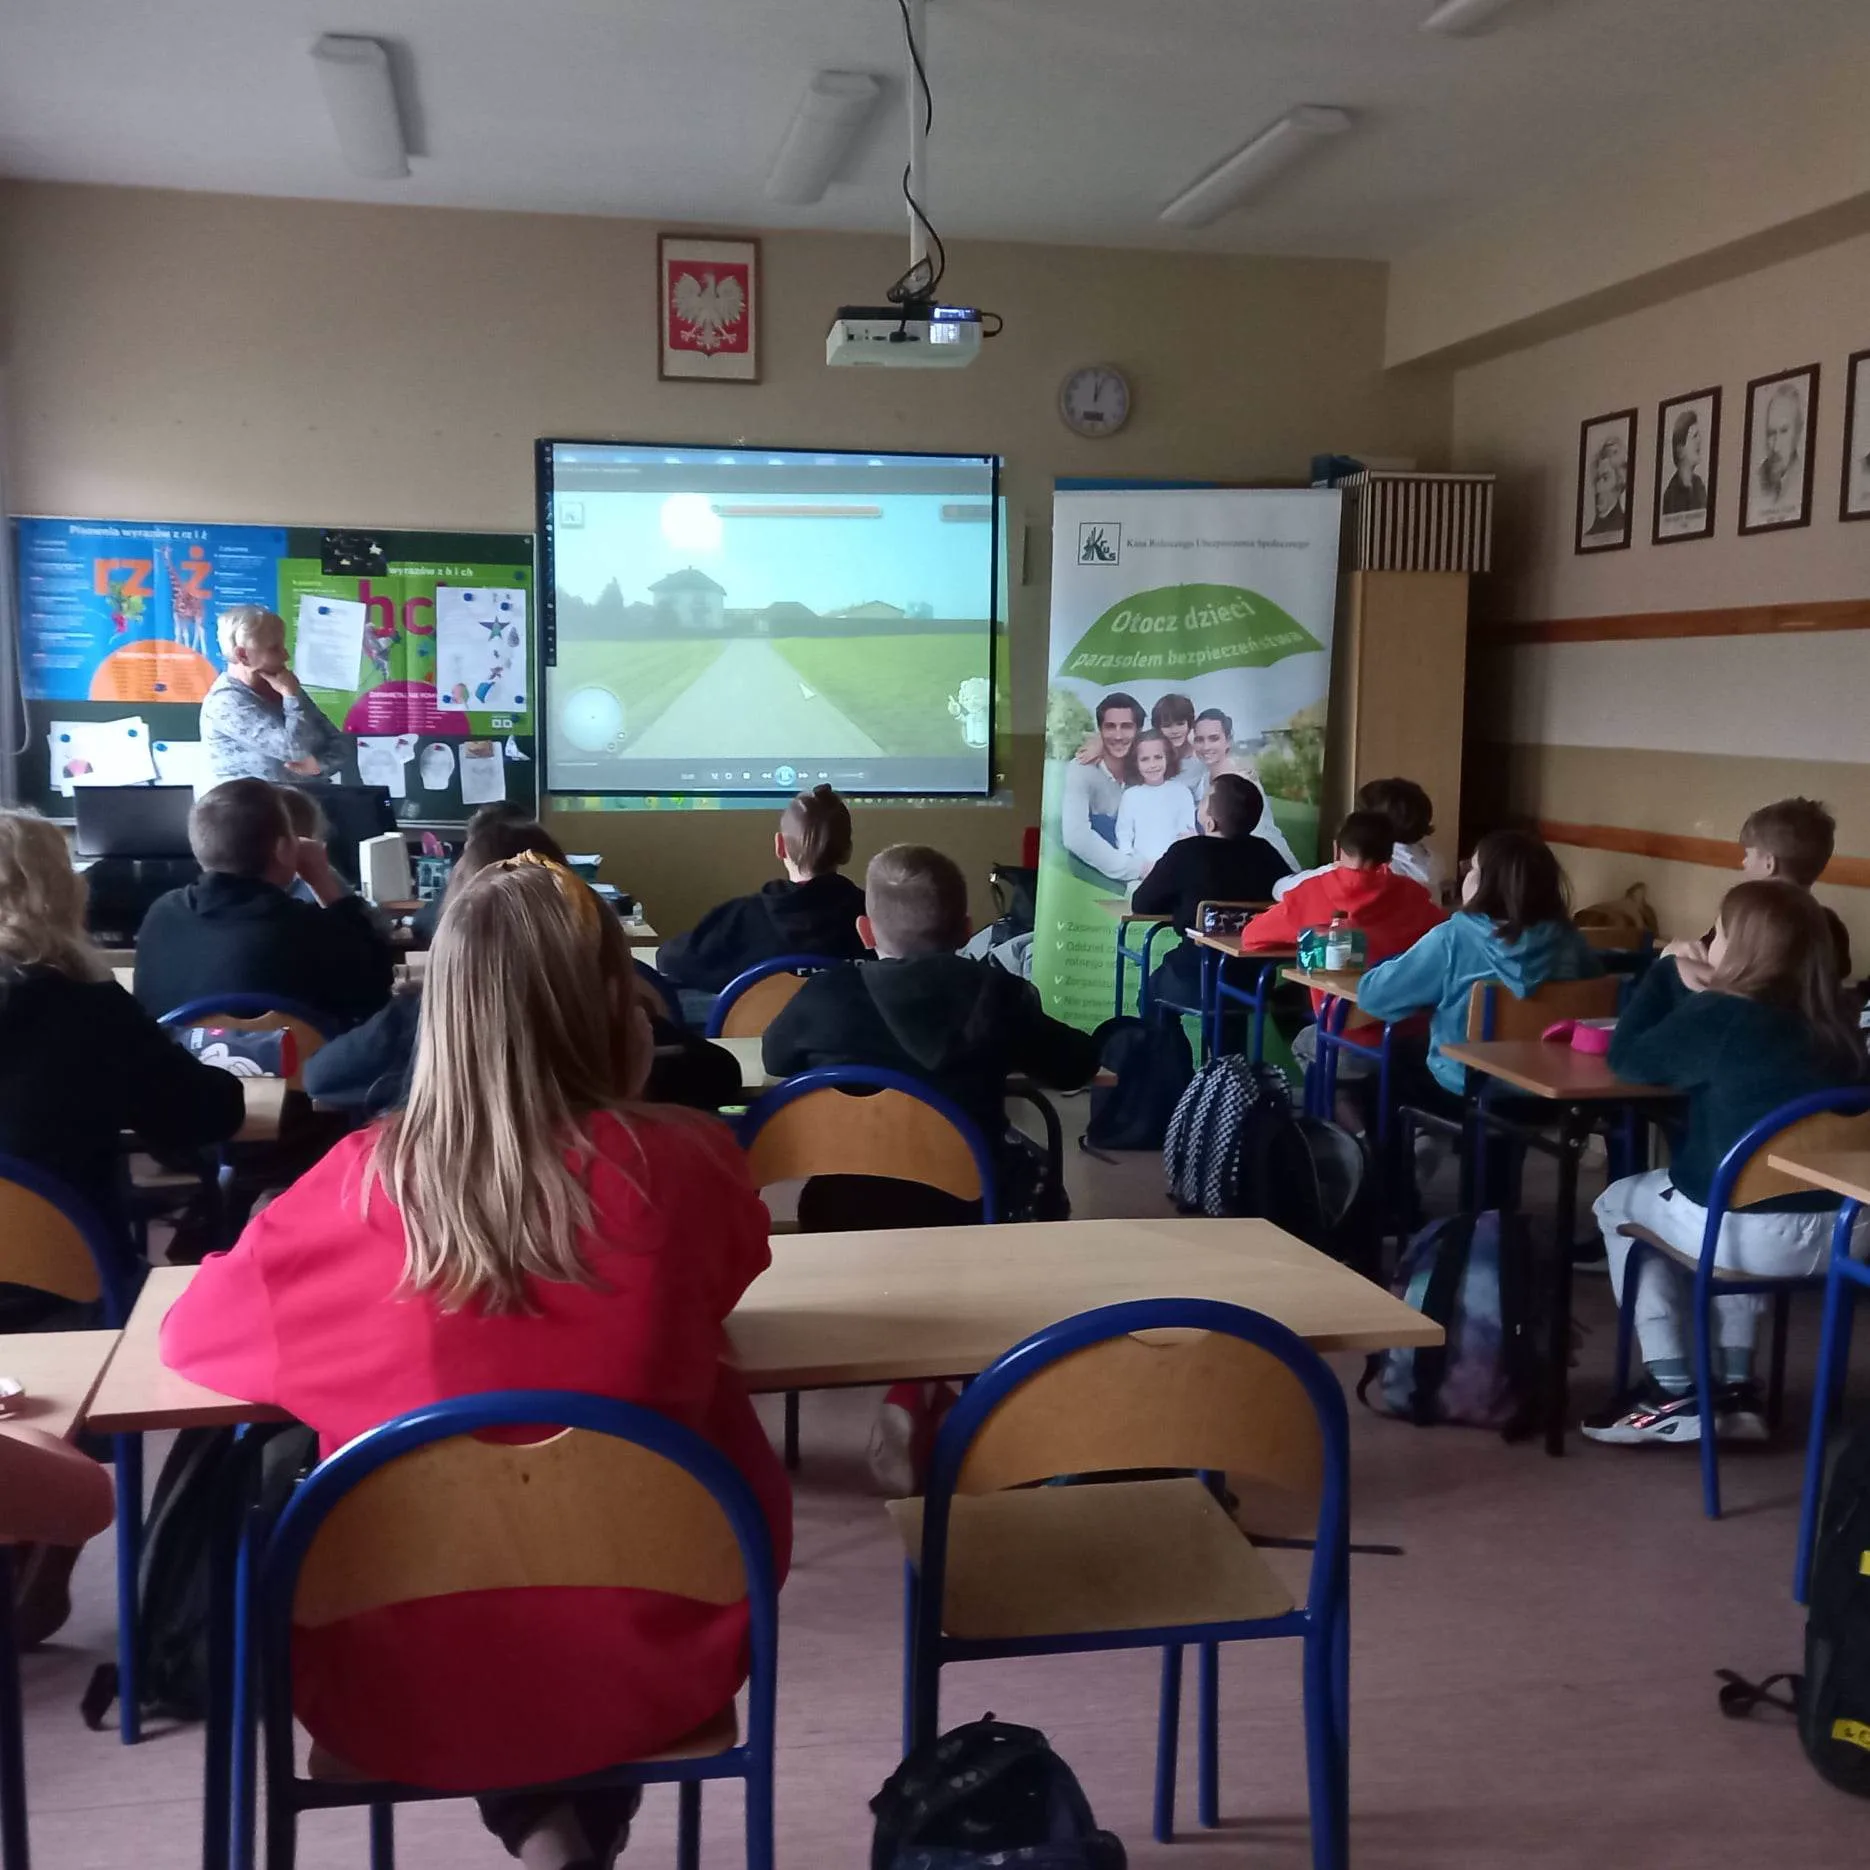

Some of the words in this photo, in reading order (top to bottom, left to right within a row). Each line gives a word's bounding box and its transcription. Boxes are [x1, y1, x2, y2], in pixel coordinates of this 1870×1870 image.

[94, 557, 153, 597] rz
[182, 544, 212, 598] ż
[1110, 609, 1178, 634] Otocz
[1184, 595, 1256, 631] dzieci
[1070, 650, 1163, 671] parasolem
[1167, 630, 1305, 667] bezpieczeństwa
